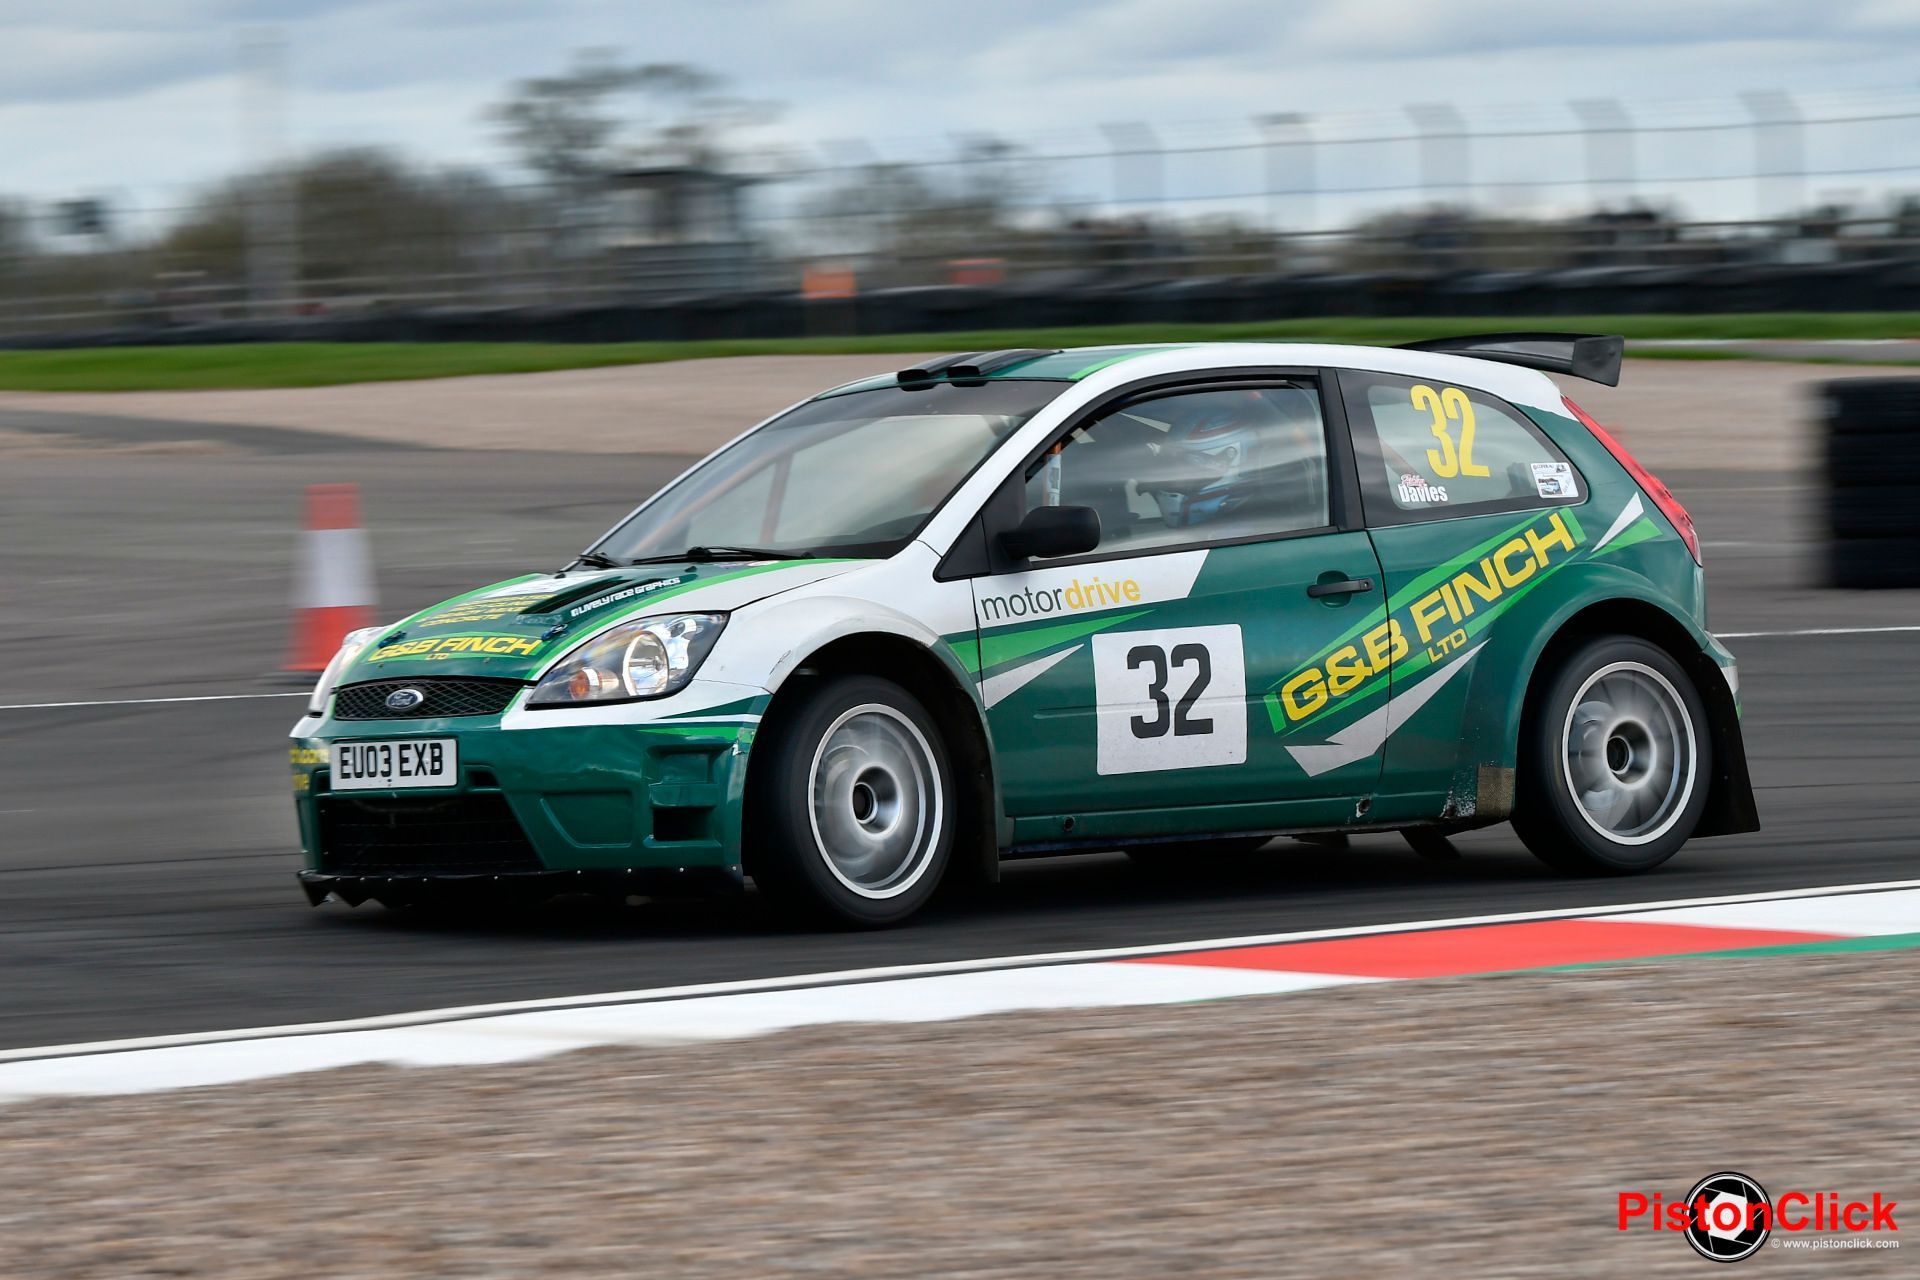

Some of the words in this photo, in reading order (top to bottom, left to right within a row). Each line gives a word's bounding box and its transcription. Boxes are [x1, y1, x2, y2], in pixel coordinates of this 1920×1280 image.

[1411, 384, 1490, 478] 32
[1398, 485, 1448, 503] Davies
[981, 575, 1141, 621] motordrive
[1281, 618, 1410, 722] G&B
[1410, 512, 1579, 645] FINCH
[425, 653, 449, 661] LTD
[434, 636, 543, 656] FINCH
[1427, 628, 1470, 664] LTD
[1127, 643, 1215, 740] 32
[340, 745, 391, 779] EU03
[399, 743, 443, 777] EXB
